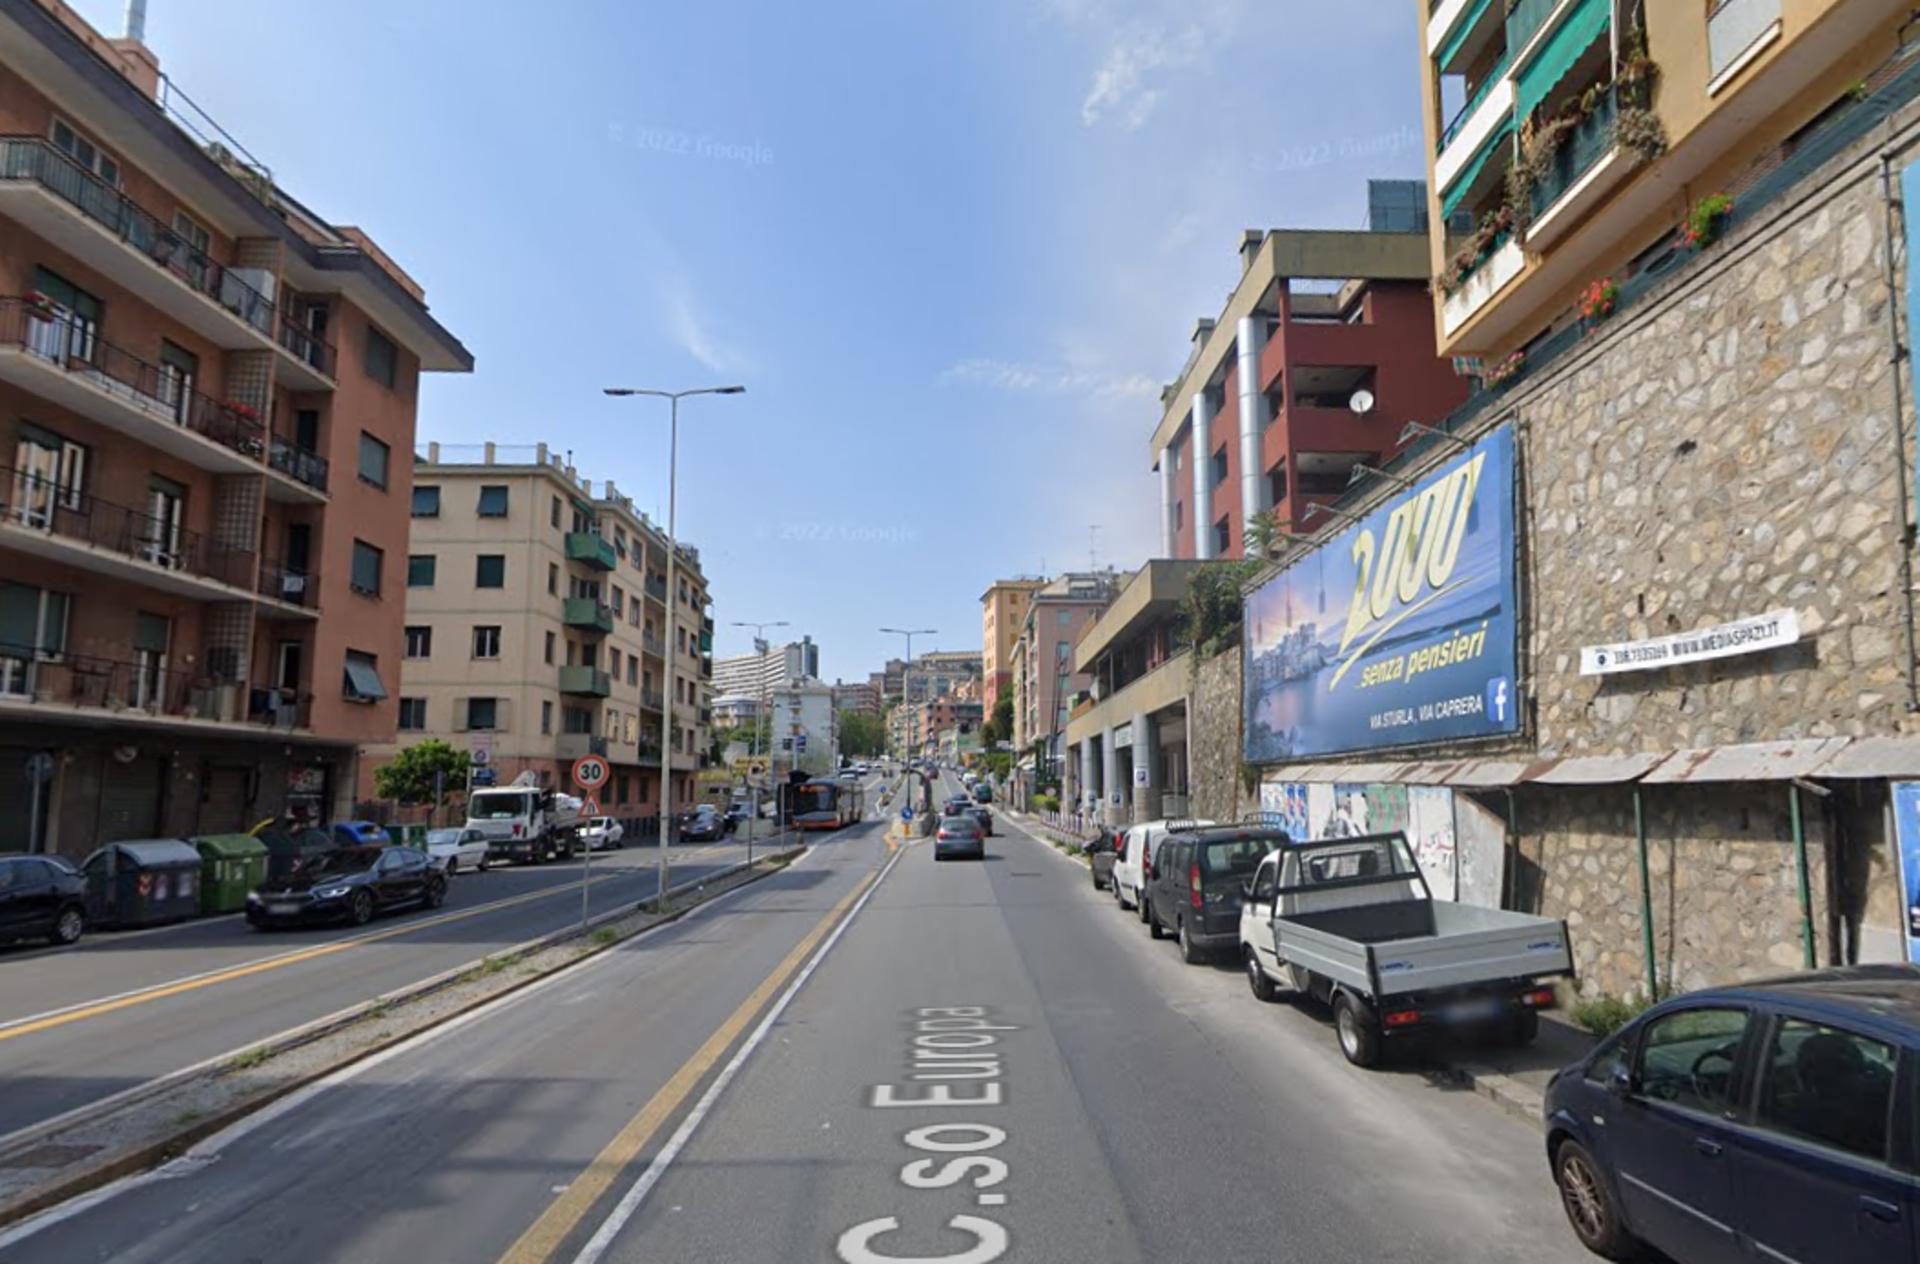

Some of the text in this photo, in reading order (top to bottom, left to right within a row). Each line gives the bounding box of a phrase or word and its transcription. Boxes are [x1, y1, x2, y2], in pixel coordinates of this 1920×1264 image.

[1340, 452, 1487, 657] 2000
[1404, 620, 1489, 684] pensieri
[1419, 704, 1434, 721] VIA
[1435, 694, 1484, 719] CAPRERA
[581, 763, 601, 780] 30
